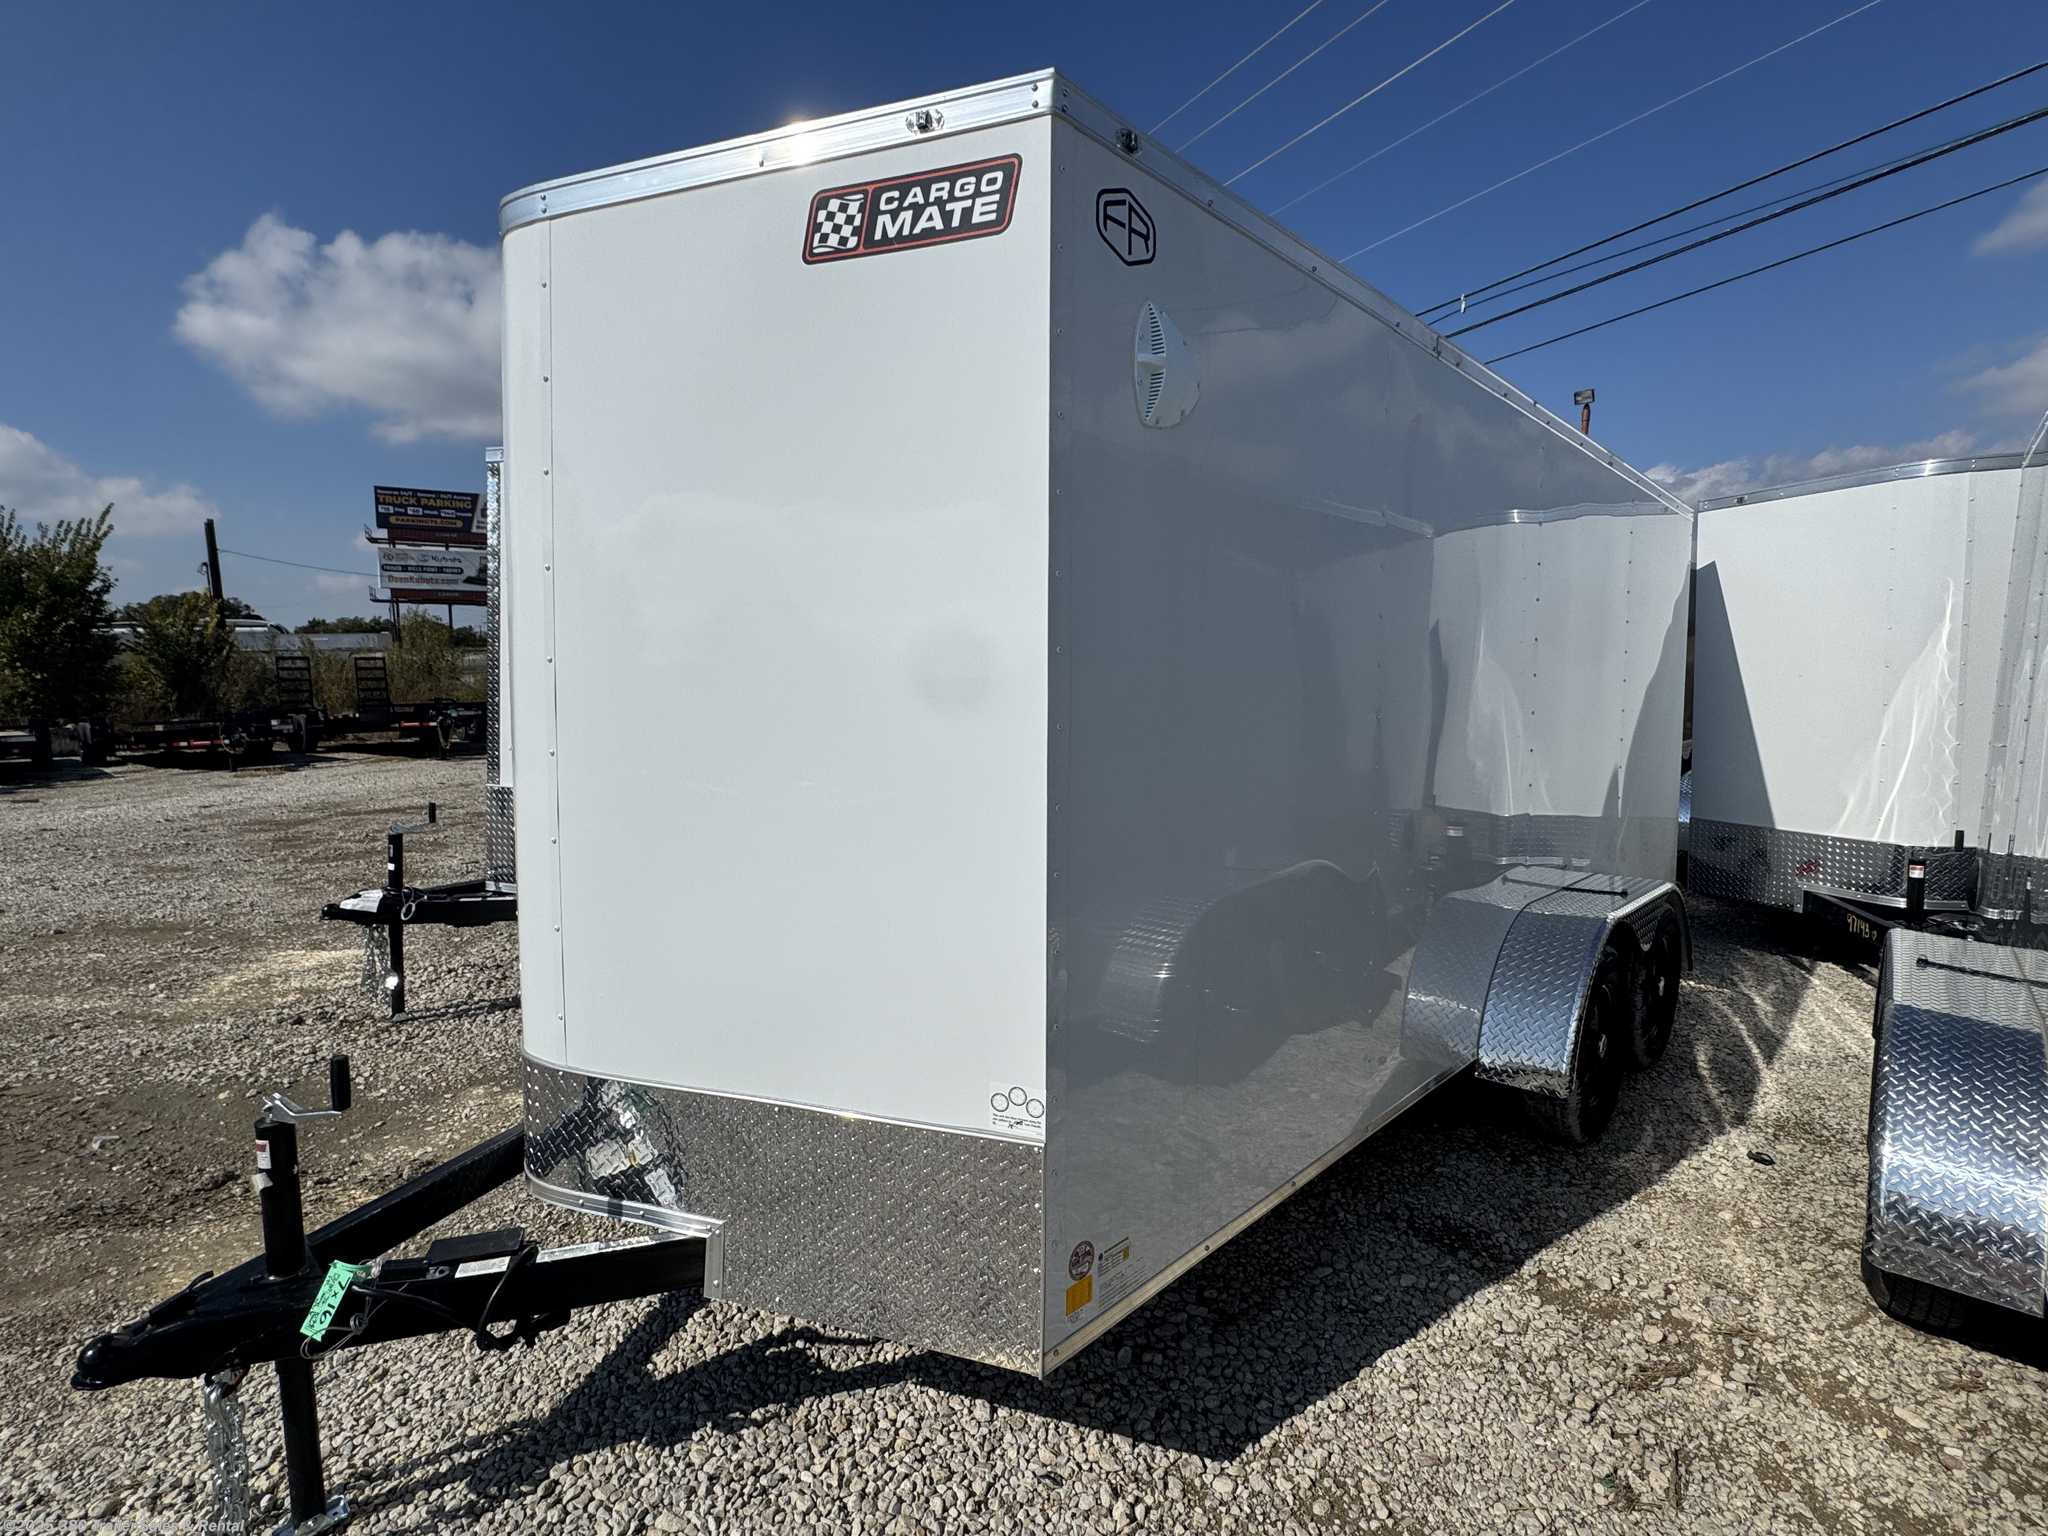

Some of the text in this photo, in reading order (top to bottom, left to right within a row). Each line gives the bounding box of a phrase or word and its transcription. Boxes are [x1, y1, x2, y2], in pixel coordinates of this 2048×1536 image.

[879, 170, 1004, 211] CARGO
[873, 193, 1001, 241] MATE
[377, 494, 472, 509] TRUCK PARKING
[431, 555, 462, 563] Kubota
[388, 574, 459, 585] DeenKubota.com
[338, 1276, 351, 1291] 7
[320, 1303, 336, 1325] 16
